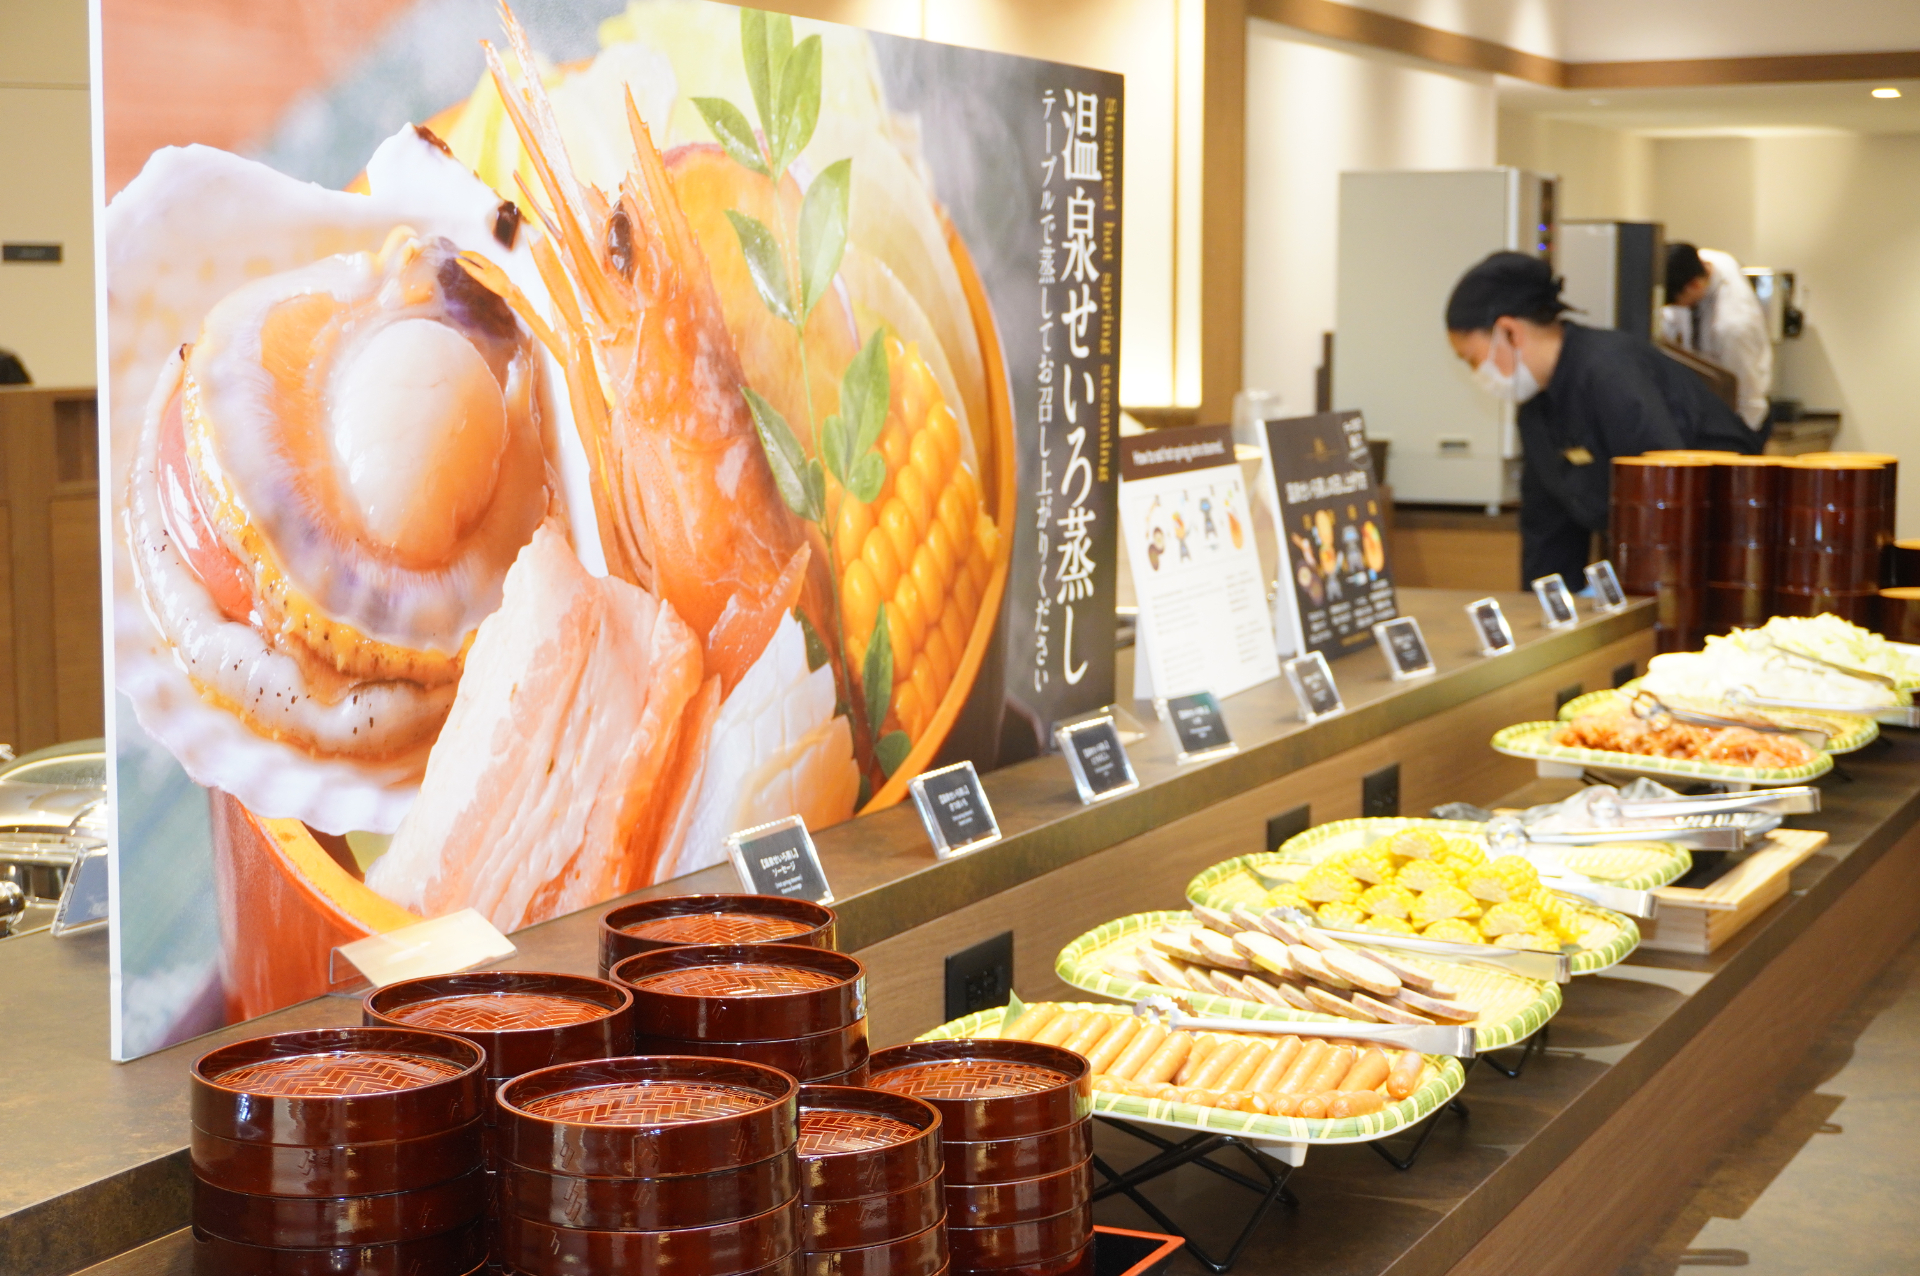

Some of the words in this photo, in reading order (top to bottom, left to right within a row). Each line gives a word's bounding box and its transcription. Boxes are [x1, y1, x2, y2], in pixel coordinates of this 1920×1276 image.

[1103, 97, 1118, 211] Steamed
[1102, 221, 1116, 263] hot
[1100, 271, 1115, 356] spring
[1034, 89, 1058, 693] テーブルで蒸してお召し上がりください
[1055, 88, 1103, 686] 温泉せいろ蒸し
[1098, 363, 1113, 483] steaming
[771, 860, 796, 878] ソーセージ
